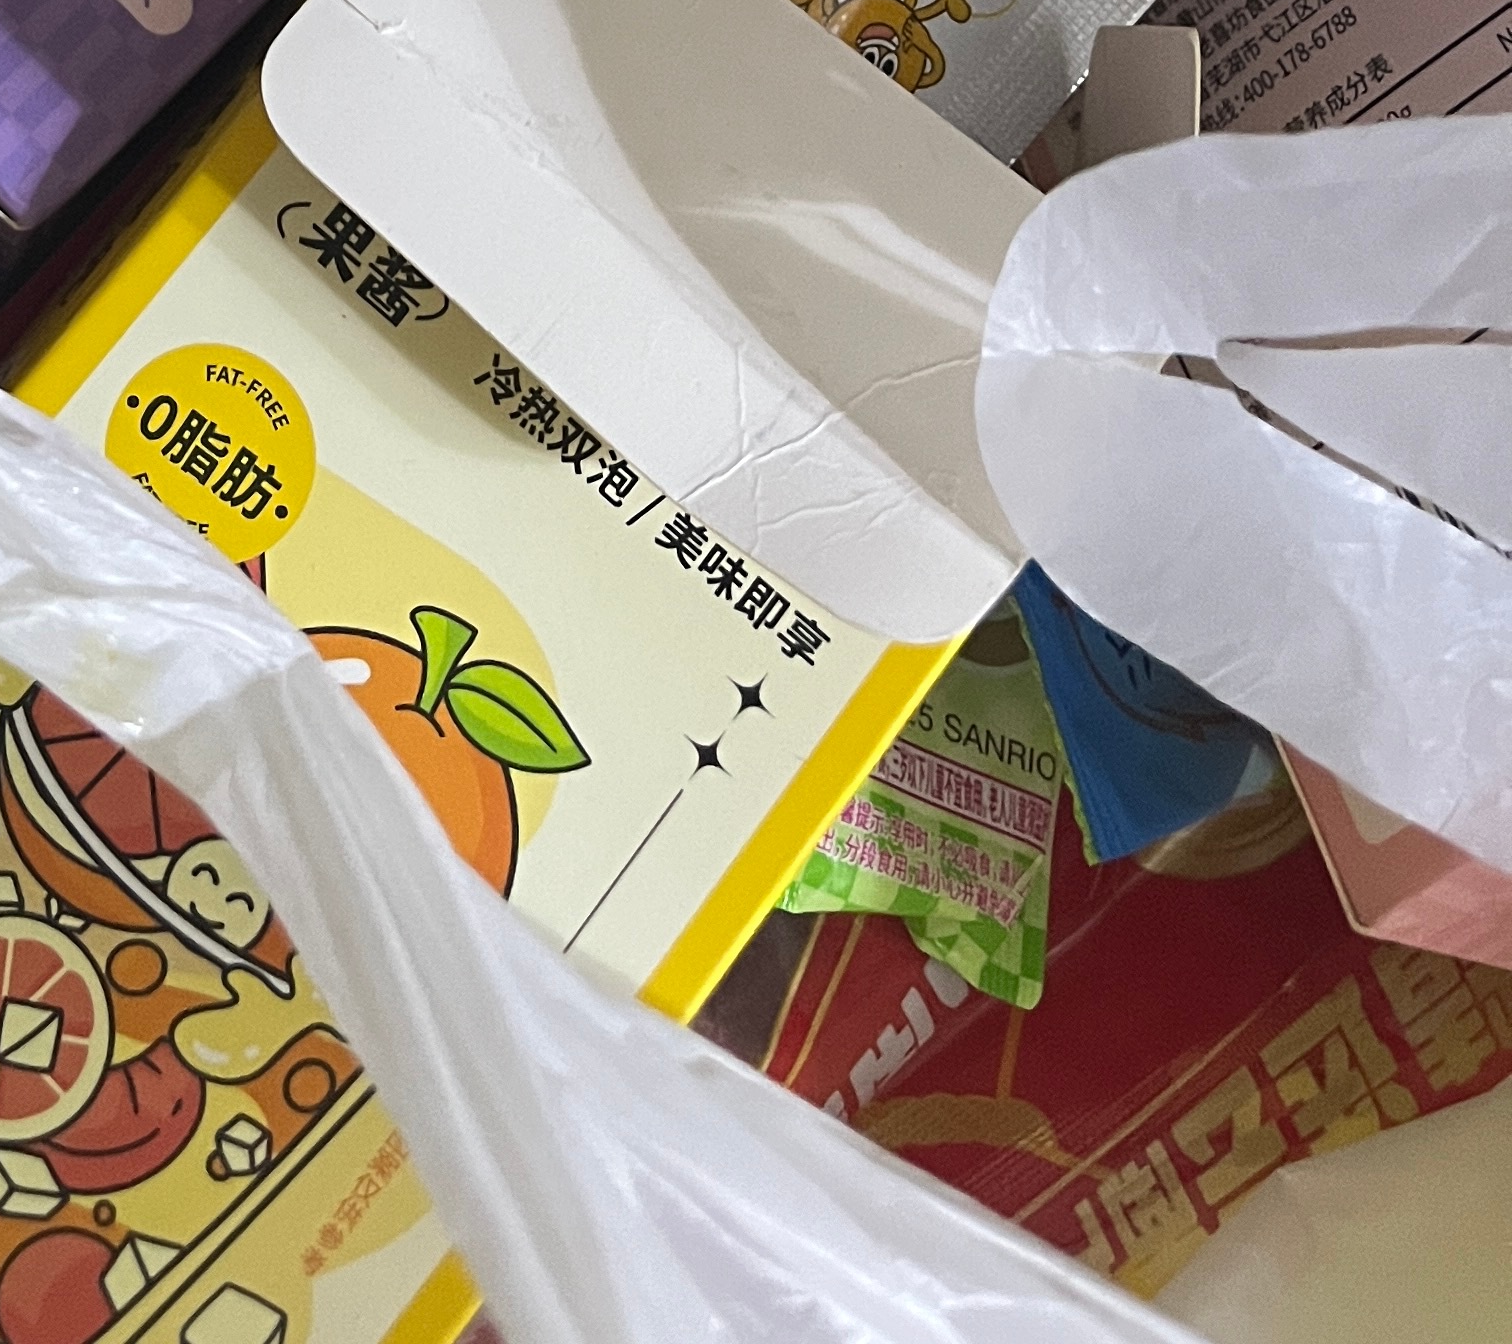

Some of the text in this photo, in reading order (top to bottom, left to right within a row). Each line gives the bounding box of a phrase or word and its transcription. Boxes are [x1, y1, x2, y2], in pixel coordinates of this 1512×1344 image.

[275, 199, 454, 327] (果酱)
[204, 360, 291, 433] FAT-FREE
[943, 713, 1058, 782] SANRIO
